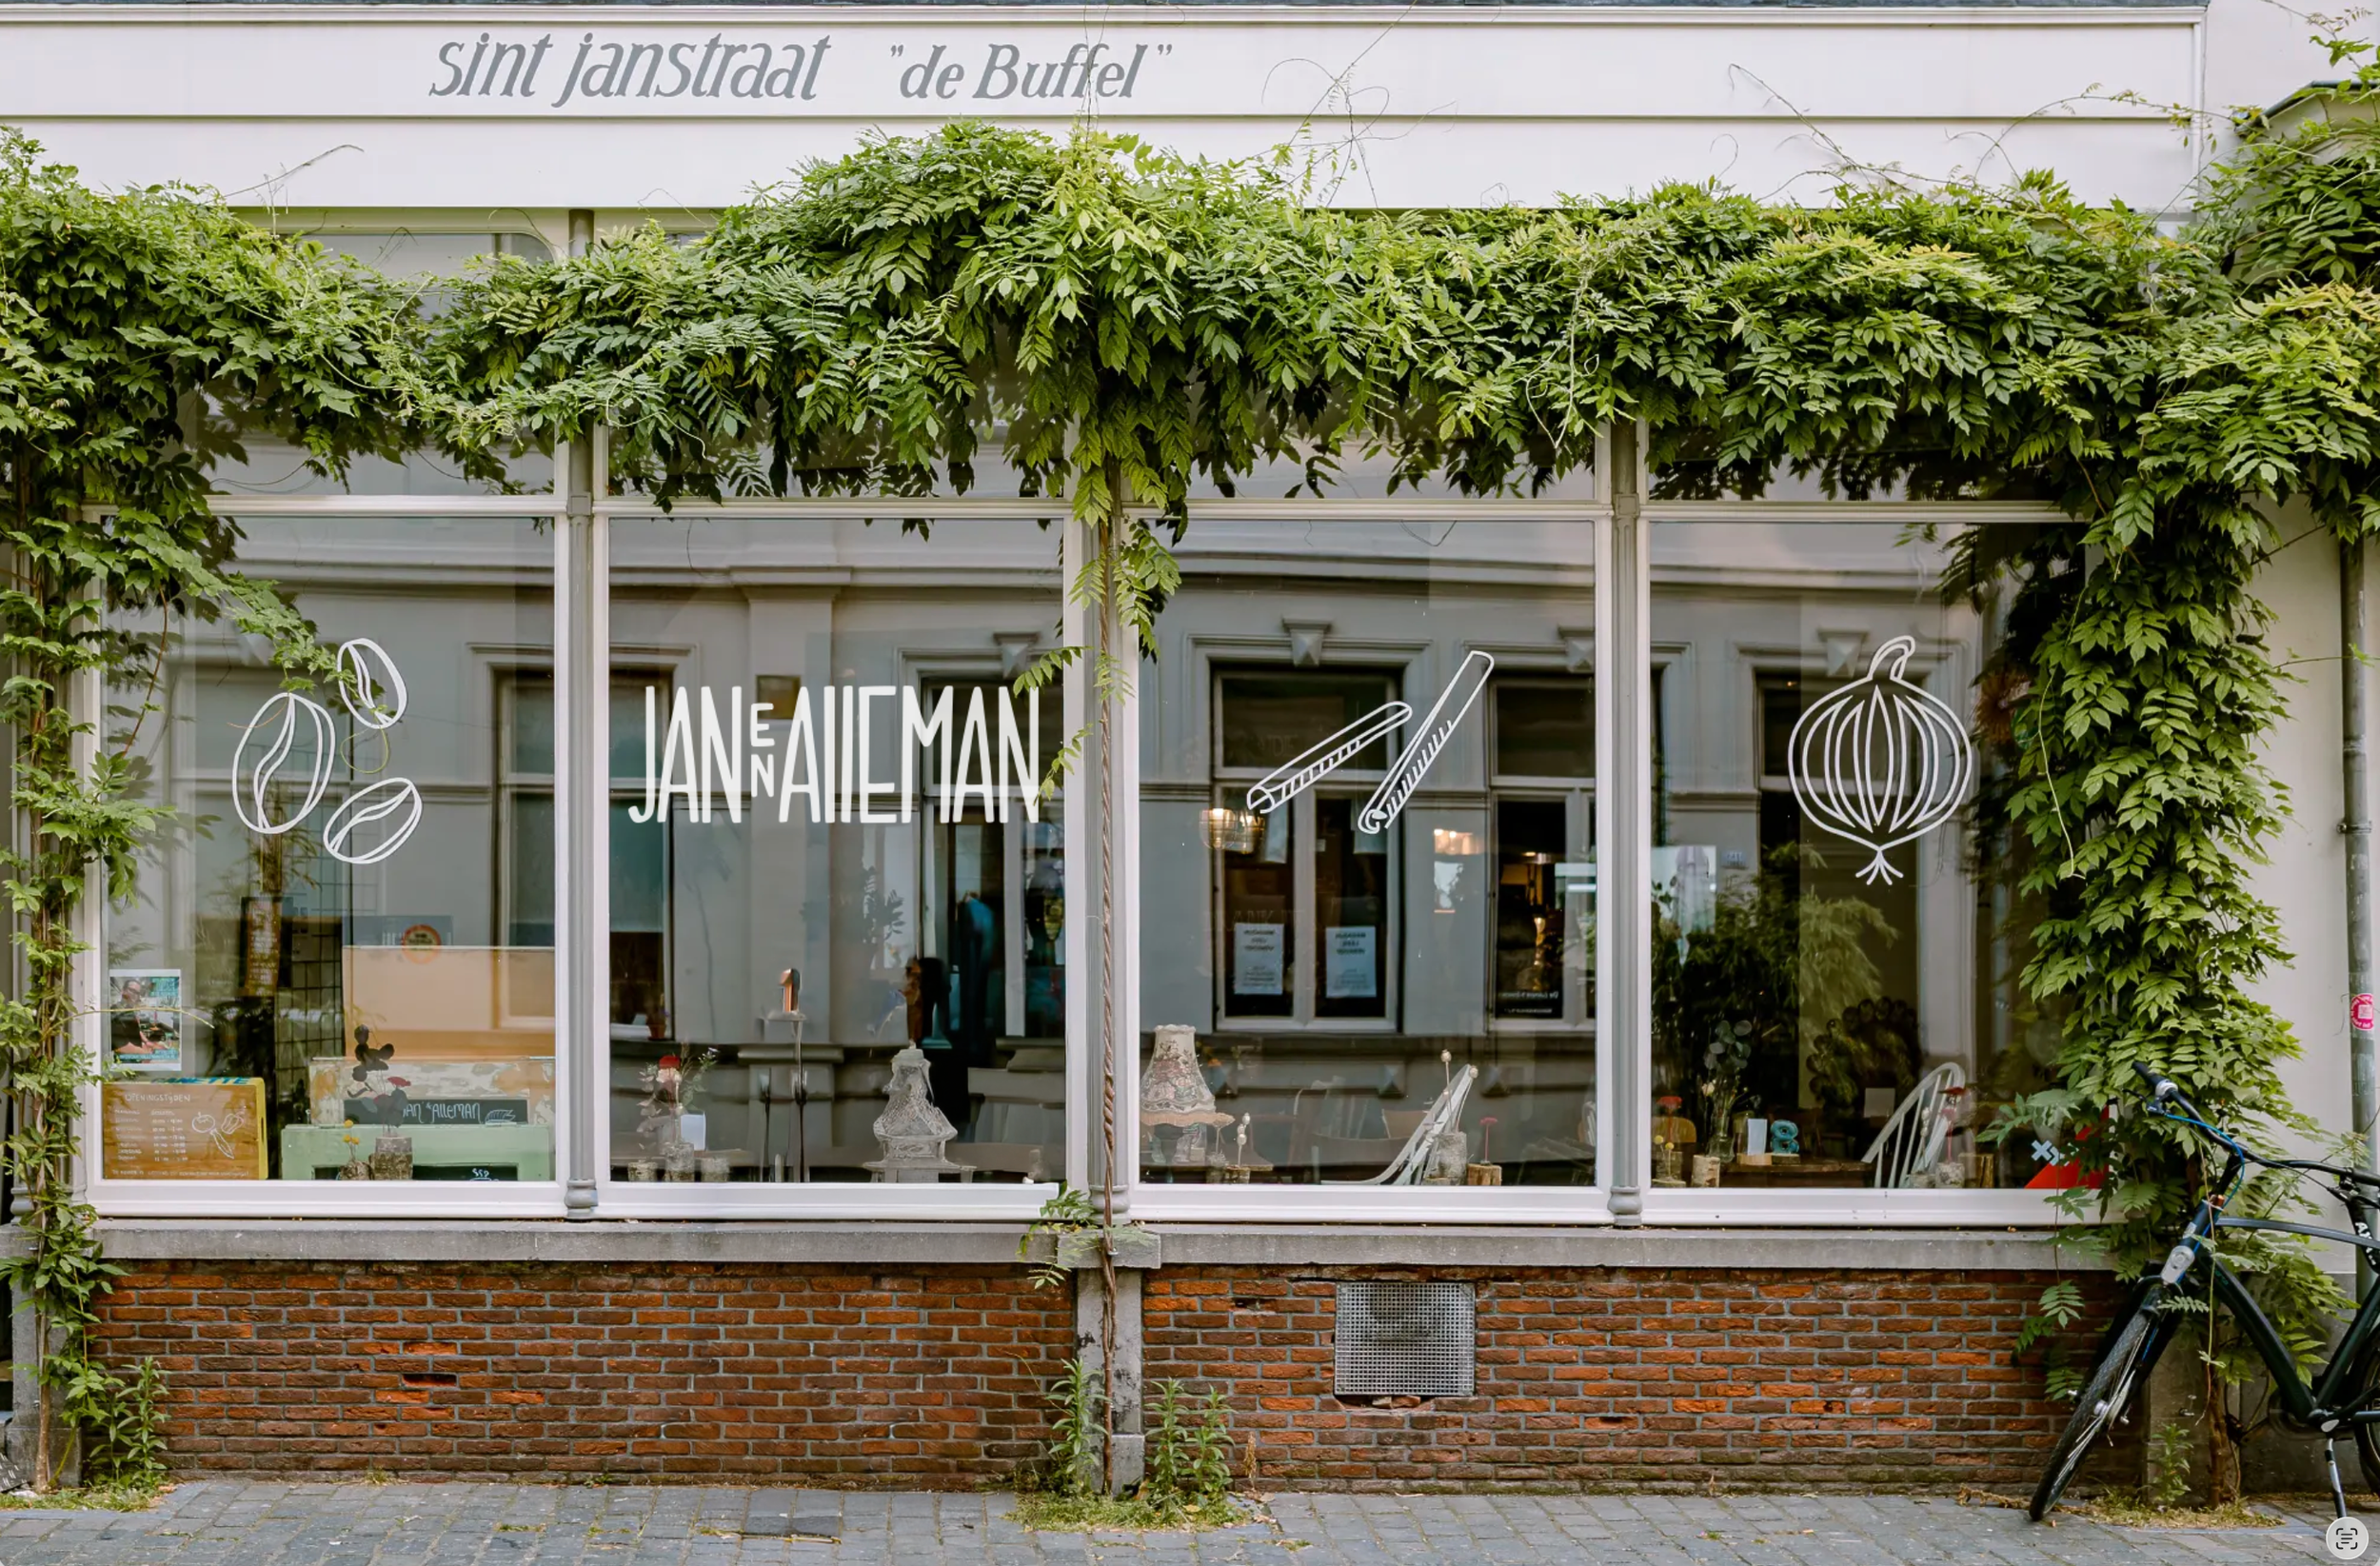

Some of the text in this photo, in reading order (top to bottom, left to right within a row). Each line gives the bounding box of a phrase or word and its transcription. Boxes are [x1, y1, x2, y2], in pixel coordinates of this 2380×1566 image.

[428, 31, 554, 98] sint
[550, 31, 832, 109] janstraat
[628, 685, 742, 823] JAN
